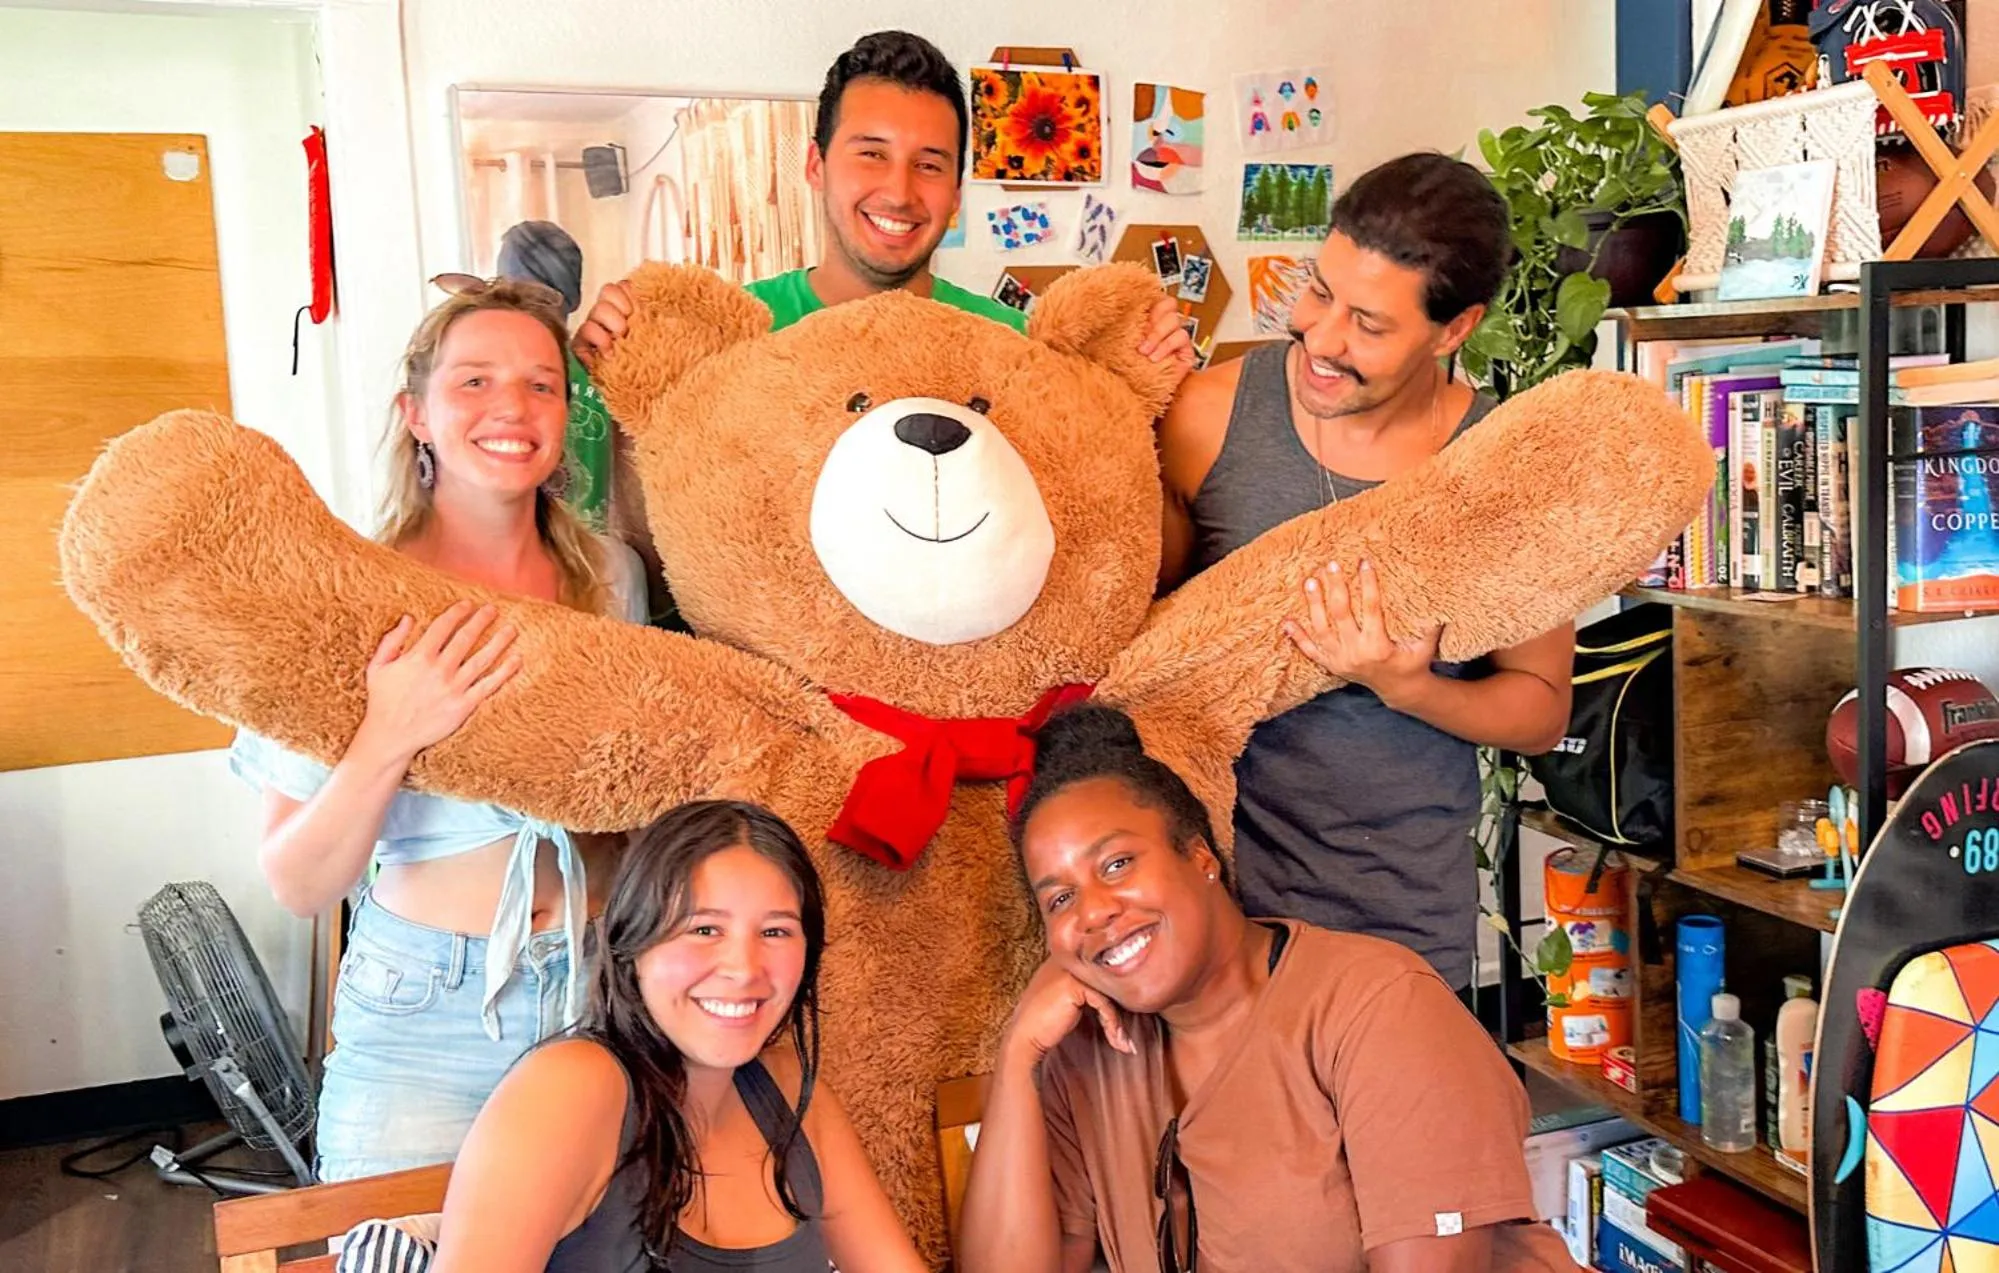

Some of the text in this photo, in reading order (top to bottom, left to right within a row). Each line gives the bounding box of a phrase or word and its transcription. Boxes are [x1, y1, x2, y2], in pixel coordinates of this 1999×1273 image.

[1778, 460, 1793, 496] EVIL
[1793, 441, 1804, 487] CAREER
[1782, 503, 1795, 577] GALBRAITH
